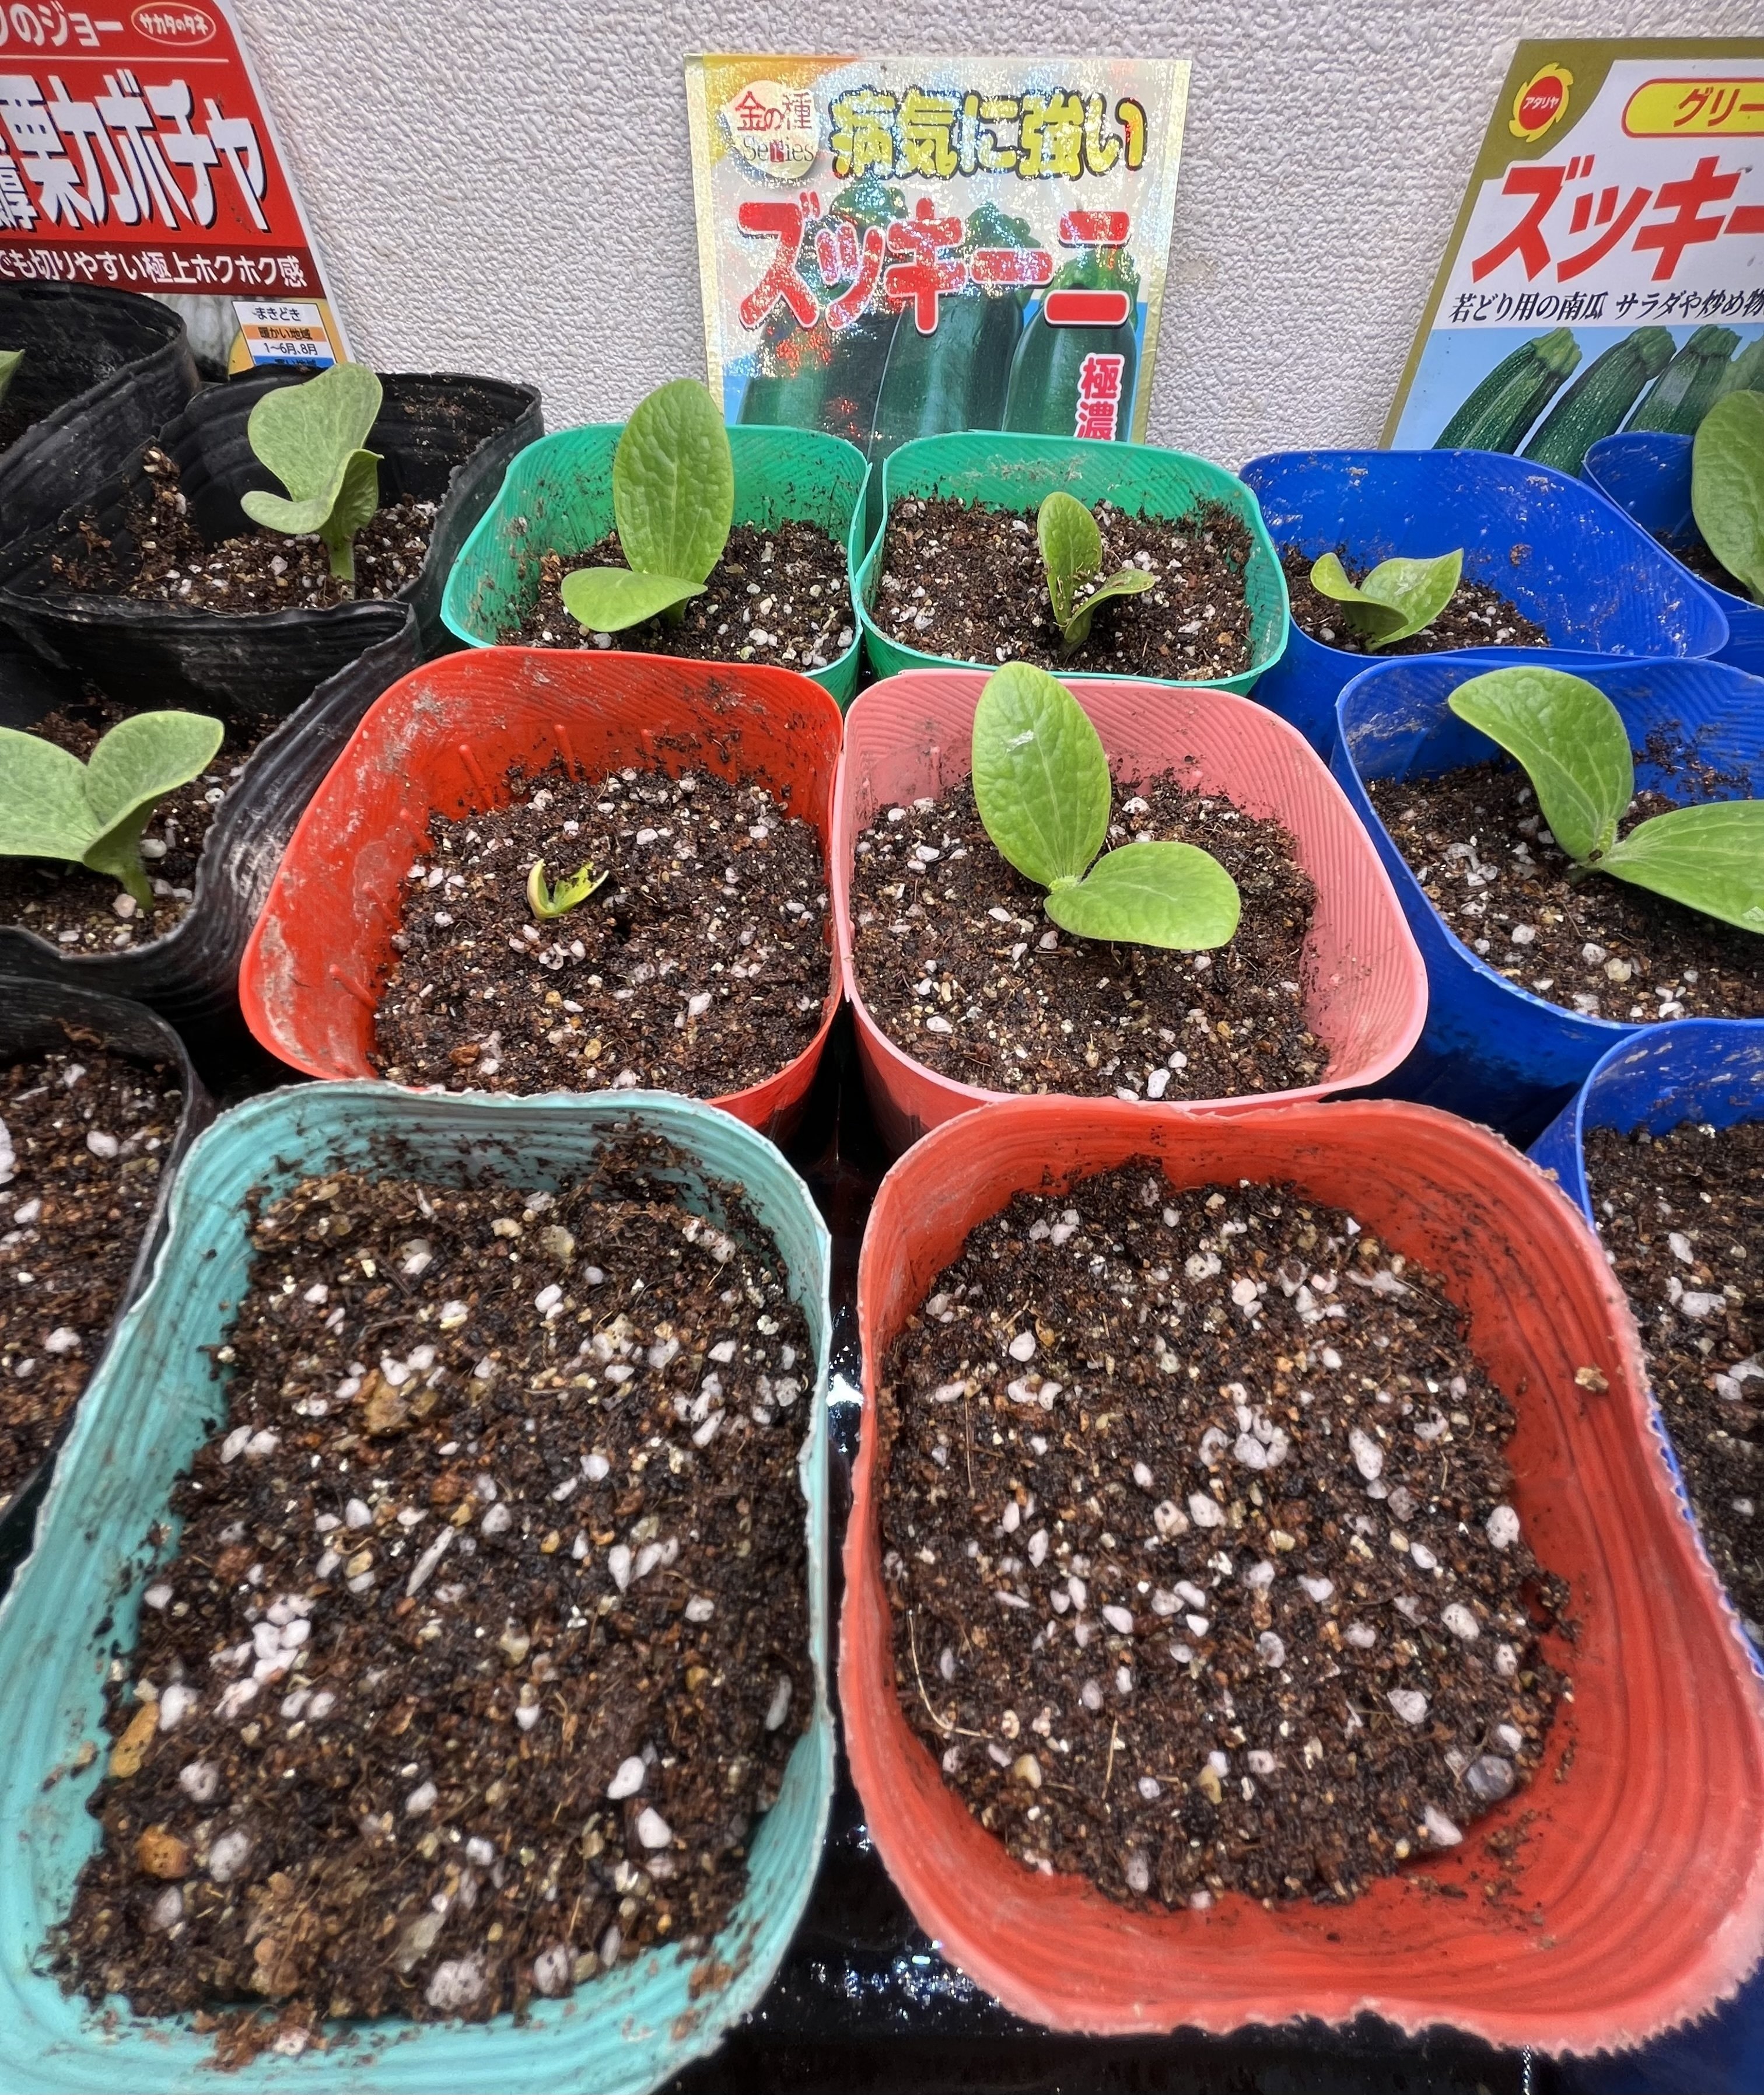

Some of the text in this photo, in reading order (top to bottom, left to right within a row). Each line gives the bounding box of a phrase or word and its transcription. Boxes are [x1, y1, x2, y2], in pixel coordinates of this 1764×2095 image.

[139, 13, 209, 35] サカタのタネ
[735, 91, 813, 131] 金の種
[1522, 96, 1560, 110] アタリヤ
[744, 136, 814, 163] Series
[829, 86, 1147, 181] 病気に強い
[1472, 154, 1764, 284] ズッキー
[0, 248, 307, 287] でも切りやすい極上ホクホク感
[737, 190, 1132, 336] ズッキーニ
[254, 307, 301, 321] まきどき
[1448, 291, 1609, 323] 若どり用の南瓜
[257, 326, 313, 340] 暖かい地域
[1077, 354, 1123, 441] 極濃
